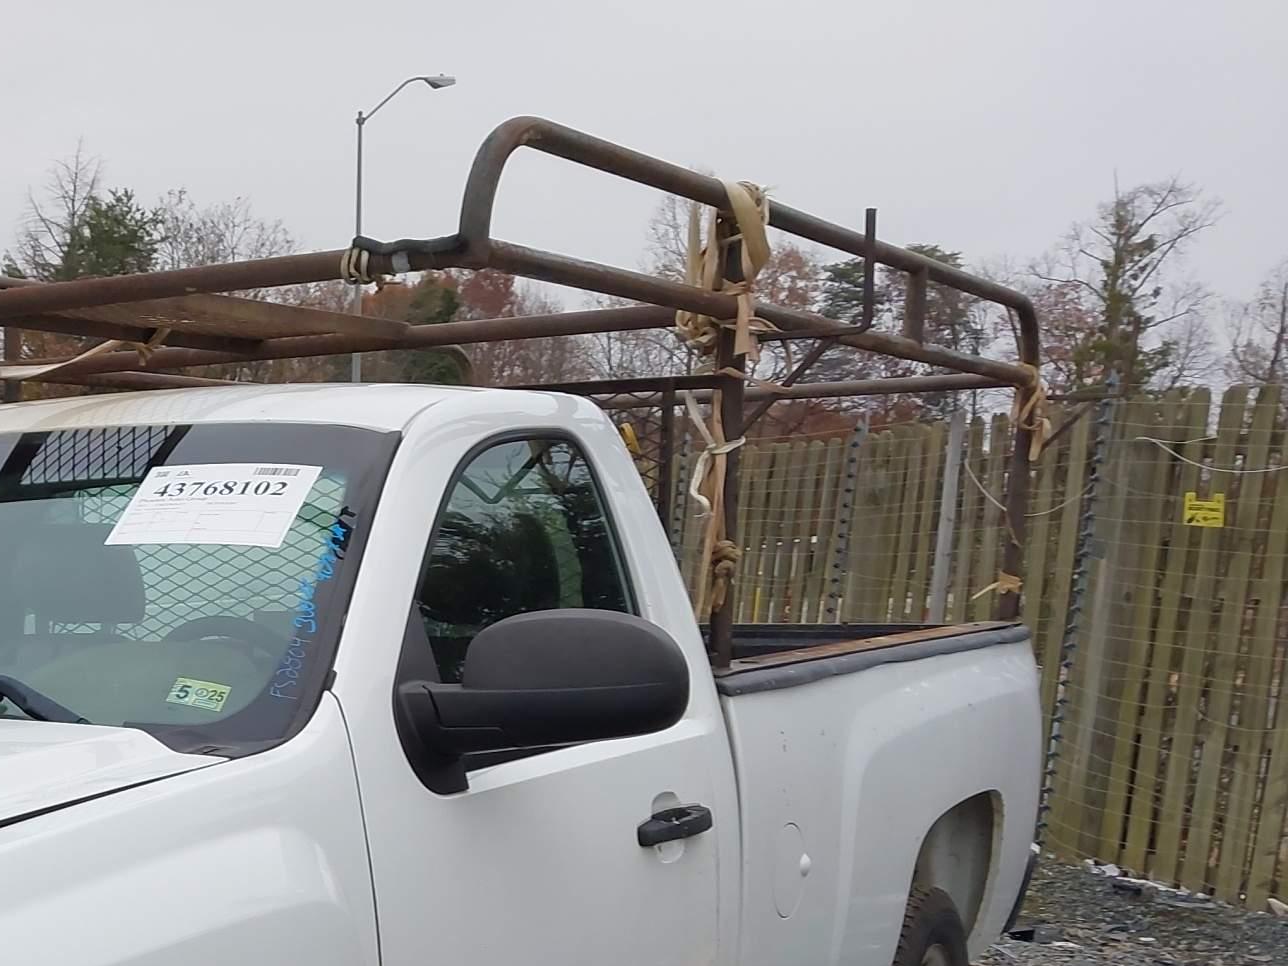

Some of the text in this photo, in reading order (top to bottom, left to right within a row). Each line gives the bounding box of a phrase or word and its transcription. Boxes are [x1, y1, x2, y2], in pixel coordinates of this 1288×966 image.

[153, 480, 289, 498] 43768102
[176, 684, 227, 703] 5 25
